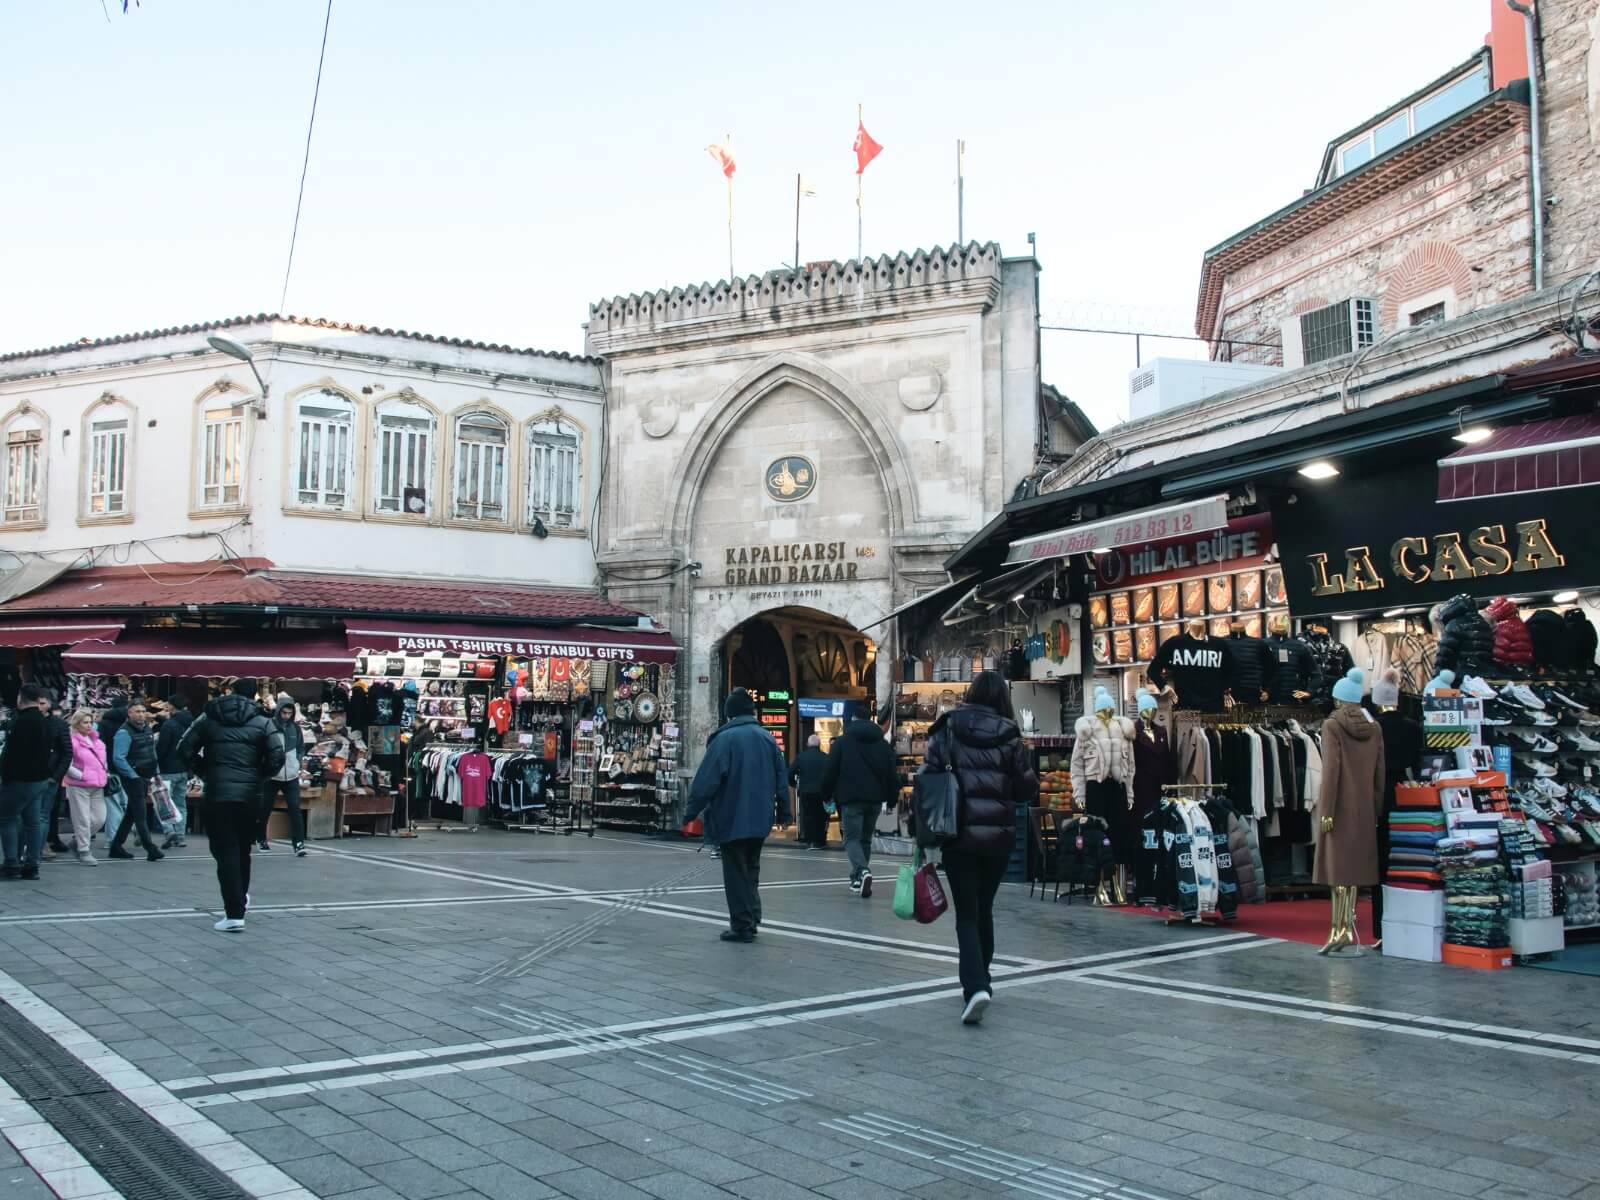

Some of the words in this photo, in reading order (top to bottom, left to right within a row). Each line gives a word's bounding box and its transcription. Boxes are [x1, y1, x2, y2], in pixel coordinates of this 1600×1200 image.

[1031, 538, 1062, 556] Hilal
[1066, 532, 1098, 551] Büfe
[1114, 524, 1142, 544] 512
[1147, 519, 1167, 538] 33
[1174, 513, 1193, 533] 12
[725, 541, 846, 565] KAPALIÇARŞI
[1129, 545, 1190, 577] HİLAL
[1196, 531, 1258, 563] BÜFE
[1304, 546, 1384, 596] LA
[1390, 518, 1565, 584] CASA
[725, 566, 782, 585] GRAND
[788, 562, 858, 582] BAZAAR
[398, 637, 447, 649] PASHA
[450, 639, 513, 653] T-SHIRTS
[516, 643, 526, 654] &
[529, 644, 594, 658] ISTANBUL
[597, 647, 634, 660] GIFTS
[1173, 648, 1223, 668] AMIRI
